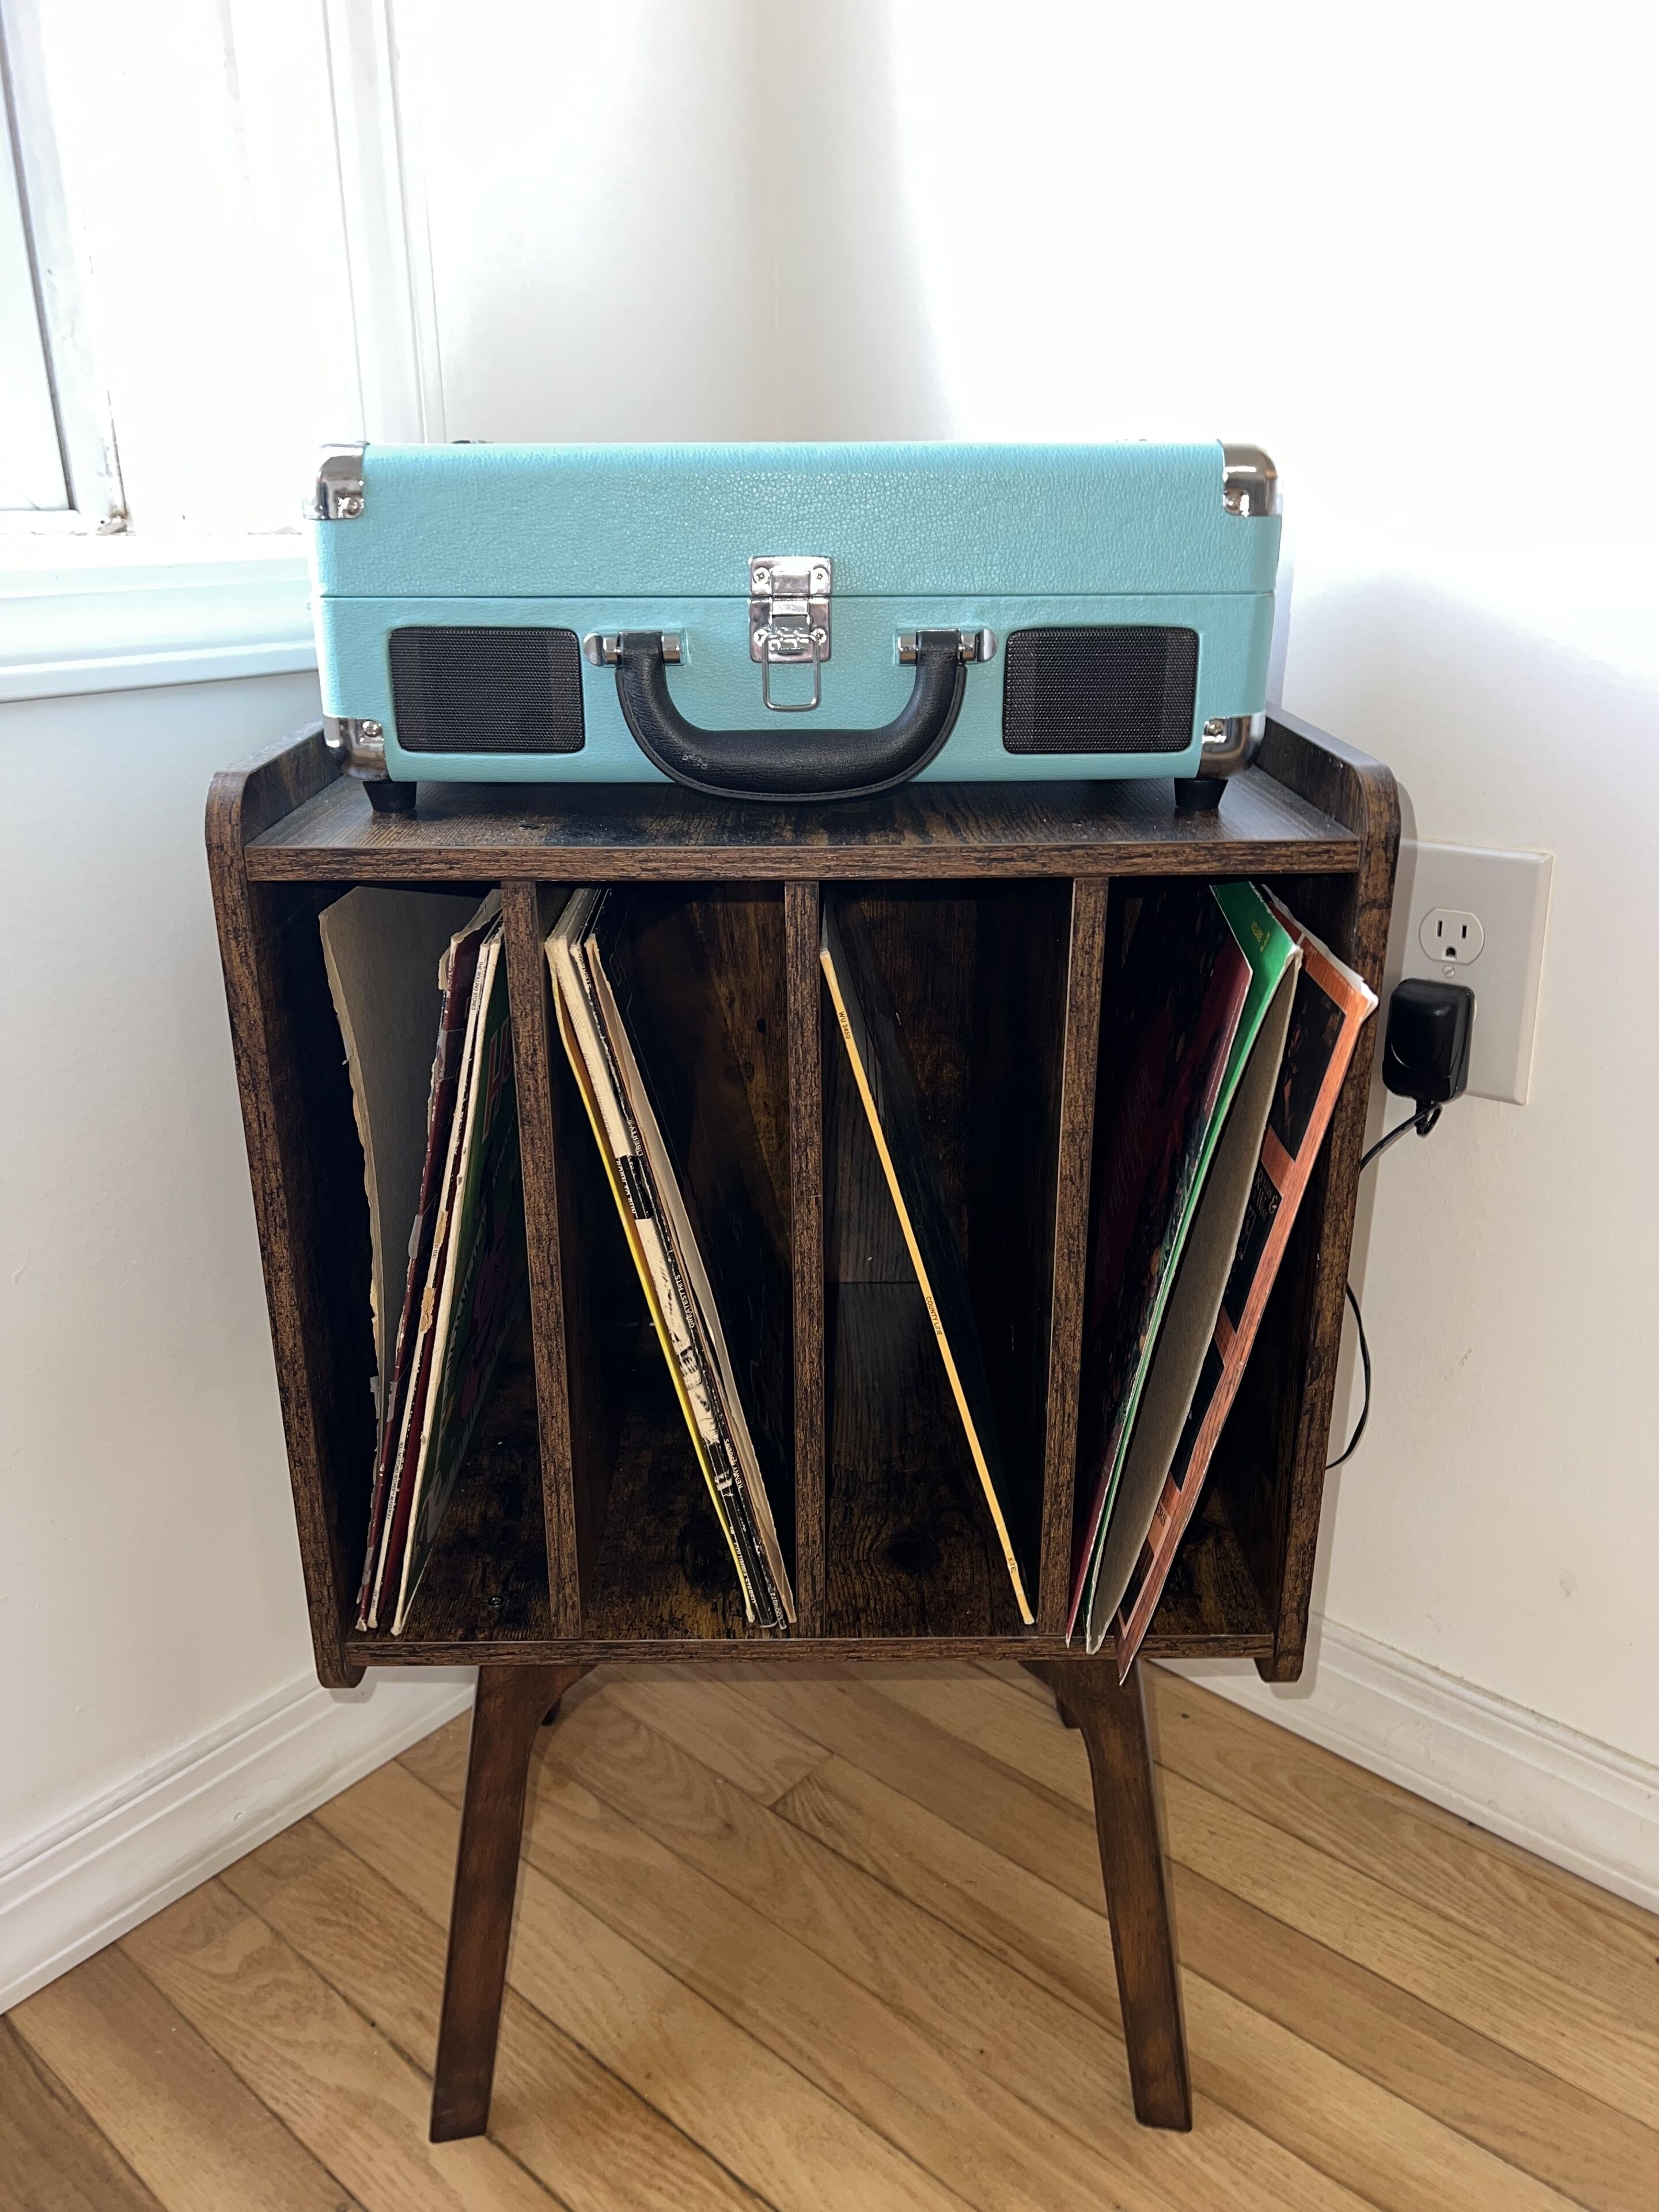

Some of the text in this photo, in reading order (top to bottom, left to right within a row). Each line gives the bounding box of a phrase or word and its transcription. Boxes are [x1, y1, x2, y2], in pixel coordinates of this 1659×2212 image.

[839, 1010, 851, 1039] WU 3450
[630, 1124, 643, 1156] LIBERTY
[674, 1274, 696, 1328] GREATEST HITS
[926, 1296, 938, 1321] COUNTY
[725, 1438, 743, 1489] KENNY ROGERS
